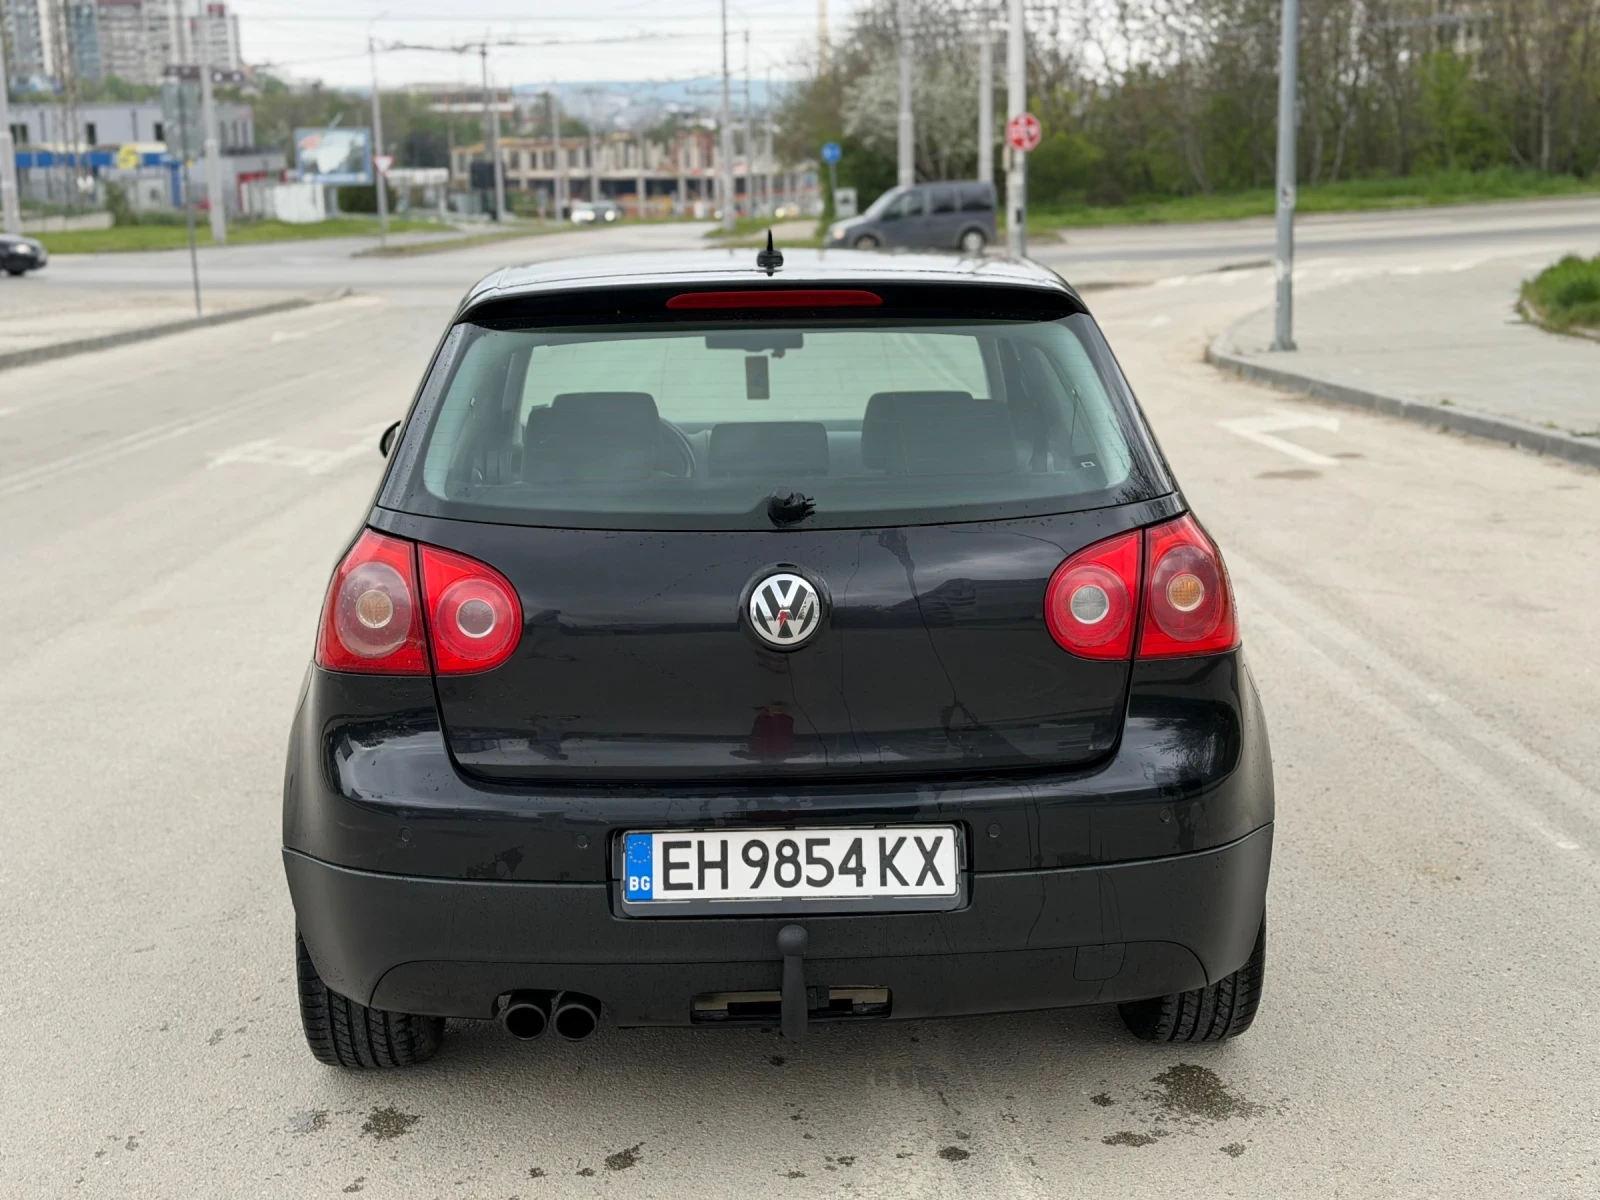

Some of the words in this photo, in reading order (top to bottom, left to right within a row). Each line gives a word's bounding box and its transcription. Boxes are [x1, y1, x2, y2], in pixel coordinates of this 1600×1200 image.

[751, 575, 820, 644] VW
[629, 876, 651, 891] BG
[662, 839, 729, 891] EH
[741, 837, 867, 889] 9854
[879, 836, 946, 887] KX
